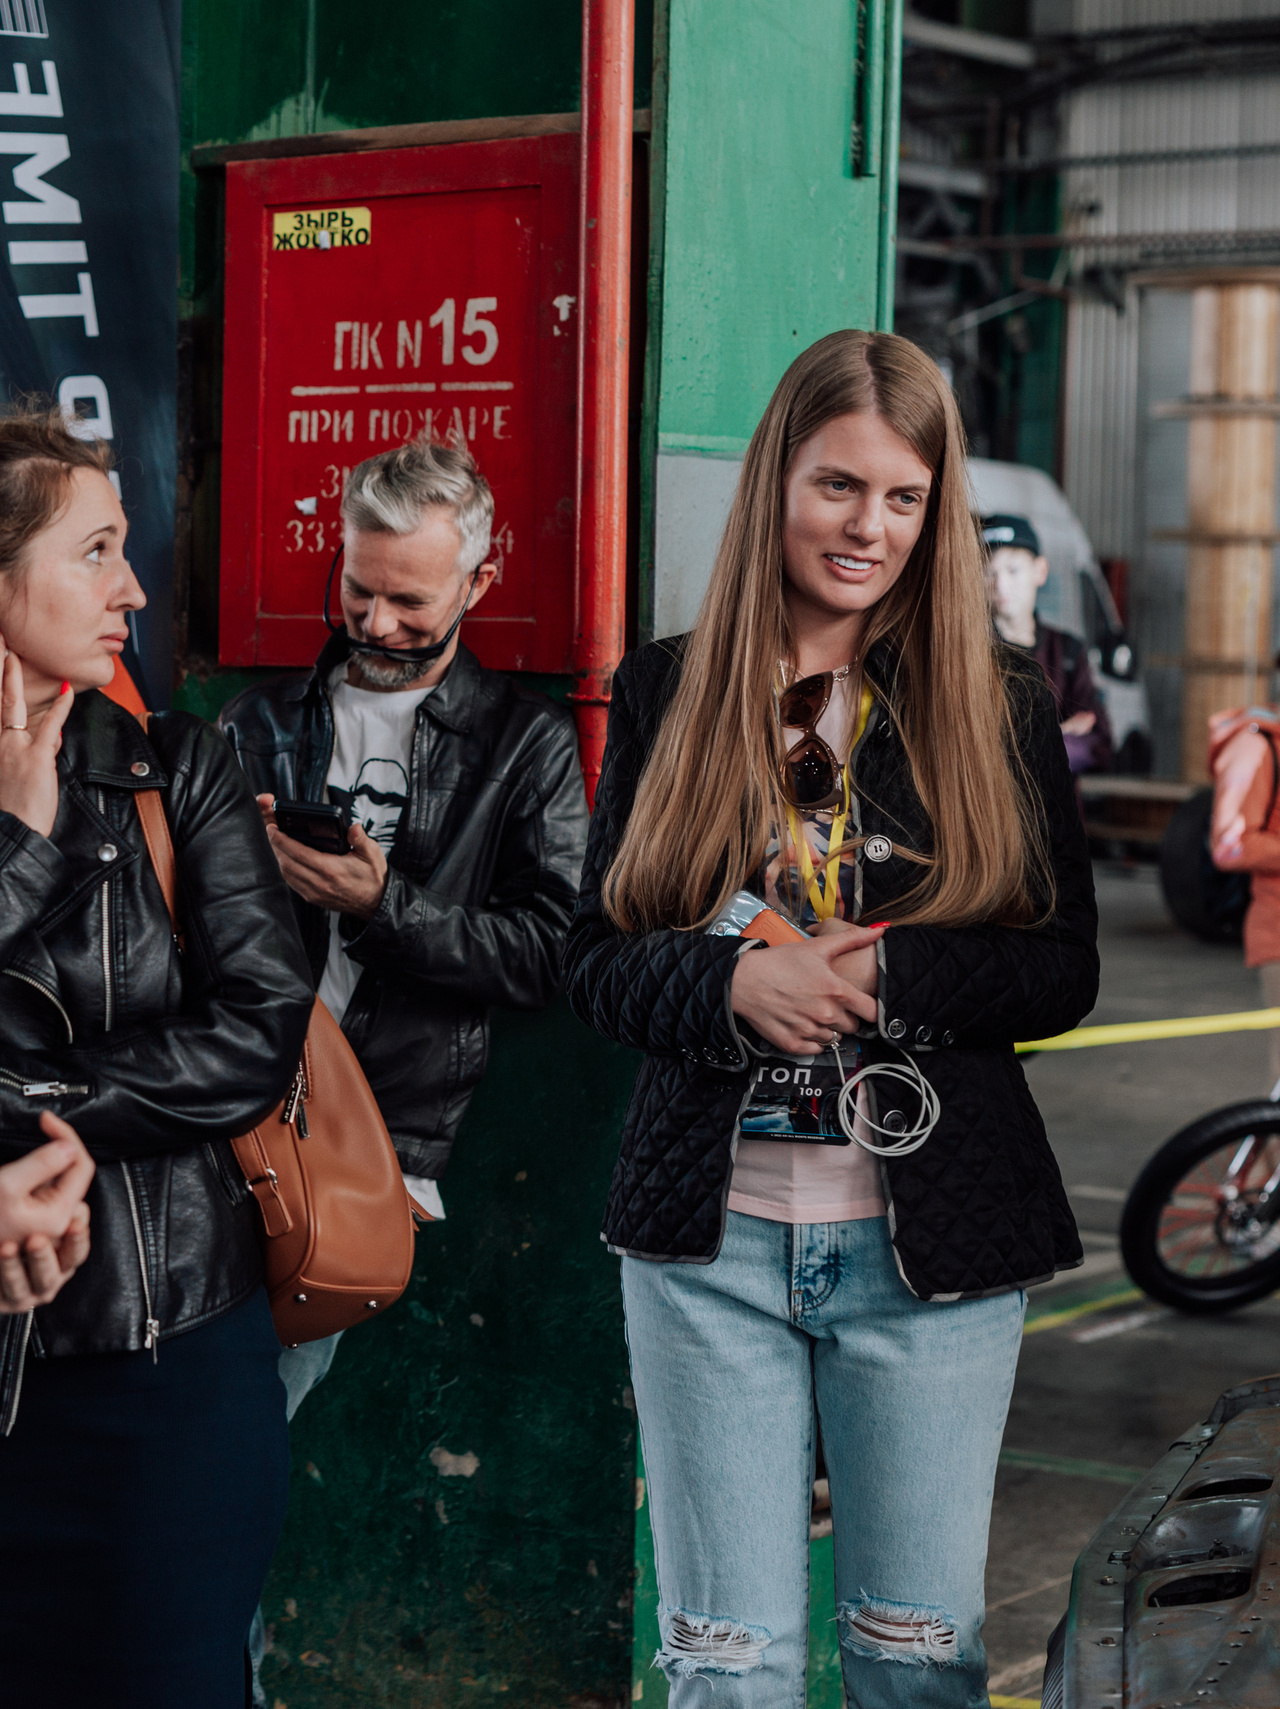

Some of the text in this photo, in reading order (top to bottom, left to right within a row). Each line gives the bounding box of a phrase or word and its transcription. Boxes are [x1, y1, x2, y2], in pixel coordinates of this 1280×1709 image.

[293, 211, 354, 231] ЗЫРЬ
[334, 321, 383, 370] ПК
[288, 405, 512, 443] ПРИ ПОЖАРЕ
[799, 1087, 822, 1097] 100
